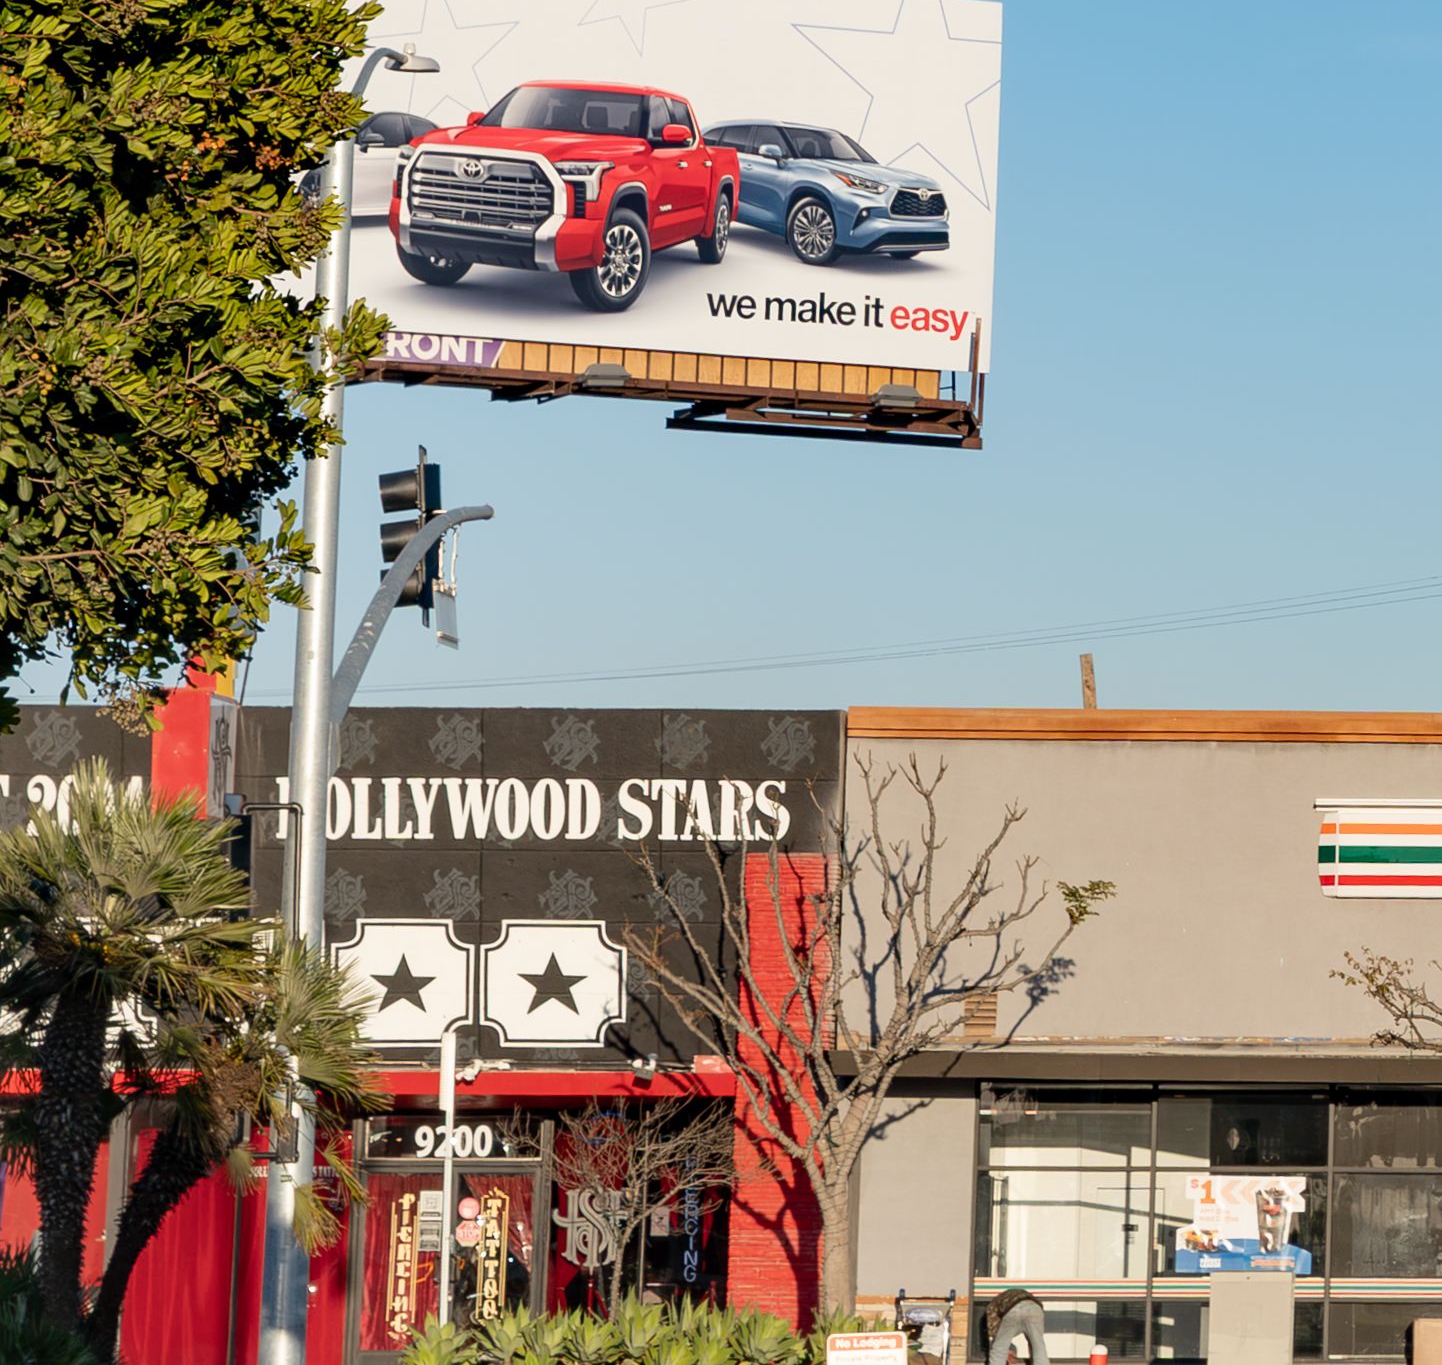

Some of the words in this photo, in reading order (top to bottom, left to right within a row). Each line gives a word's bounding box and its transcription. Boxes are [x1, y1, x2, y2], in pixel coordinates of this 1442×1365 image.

[706, 292, 757, 319] we
[764, 292, 857, 326] make
[864, 295, 884, 328] it
[890, 304, 969, 341] easy
[386, 333, 494, 364] RONT
[276, 777, 602, 841] OLLYWOOD
[617, 778, 792, 842] STARS
[414, 1124, 493, 1158] 9200
[482, 1198, 502, 1321] TATTOO
[835, 1338, 851, 1348] No
[853, 1337, 897, 1349] Lodging
